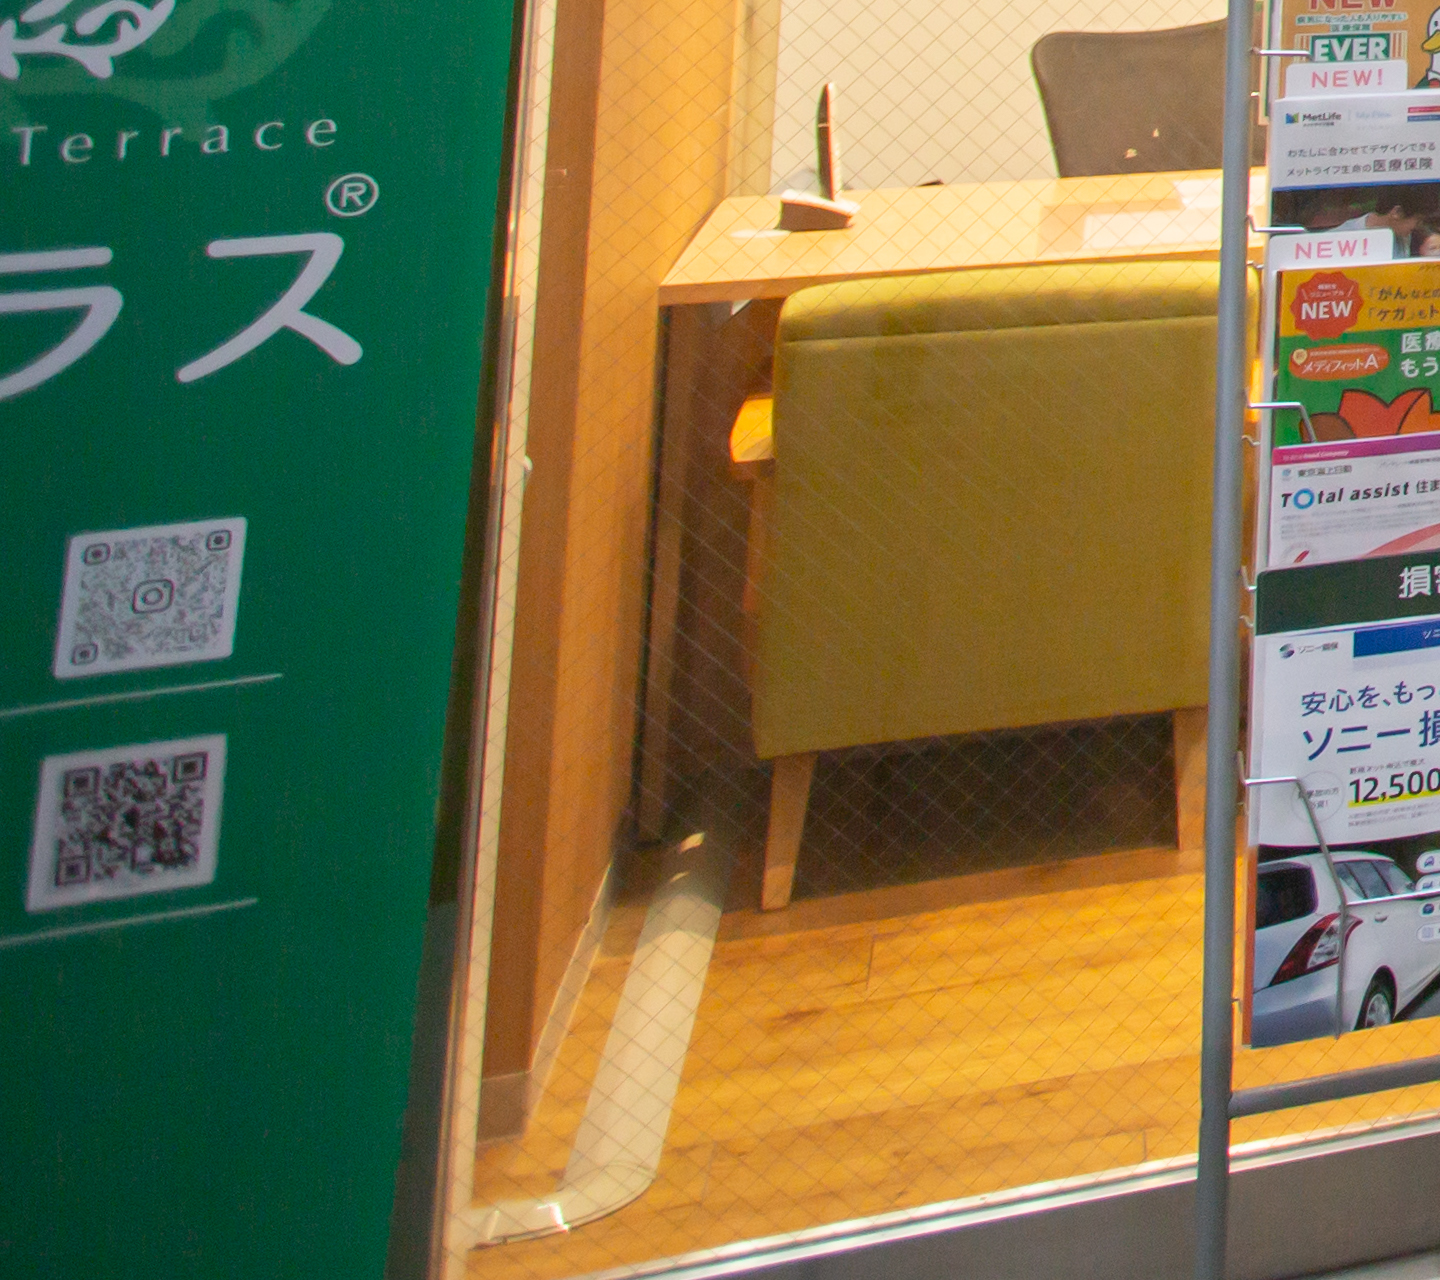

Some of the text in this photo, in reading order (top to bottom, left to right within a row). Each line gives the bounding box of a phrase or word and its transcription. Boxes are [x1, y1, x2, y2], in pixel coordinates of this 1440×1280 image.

[1313, 36, 1390, 62] EVER
[1312, 68, 1384, 88] NEW!
[1302, 112, 1342, 122] MetLife
[15, 112, 341, 165] Terrace
[1287, 157, 1433, 176] メットライフ生命の医療保険
[1295, 238, 1369, 260] NEW!
[1301, 300, 1354, 320] NEW
[1350, 481, 1410, 501] assist
